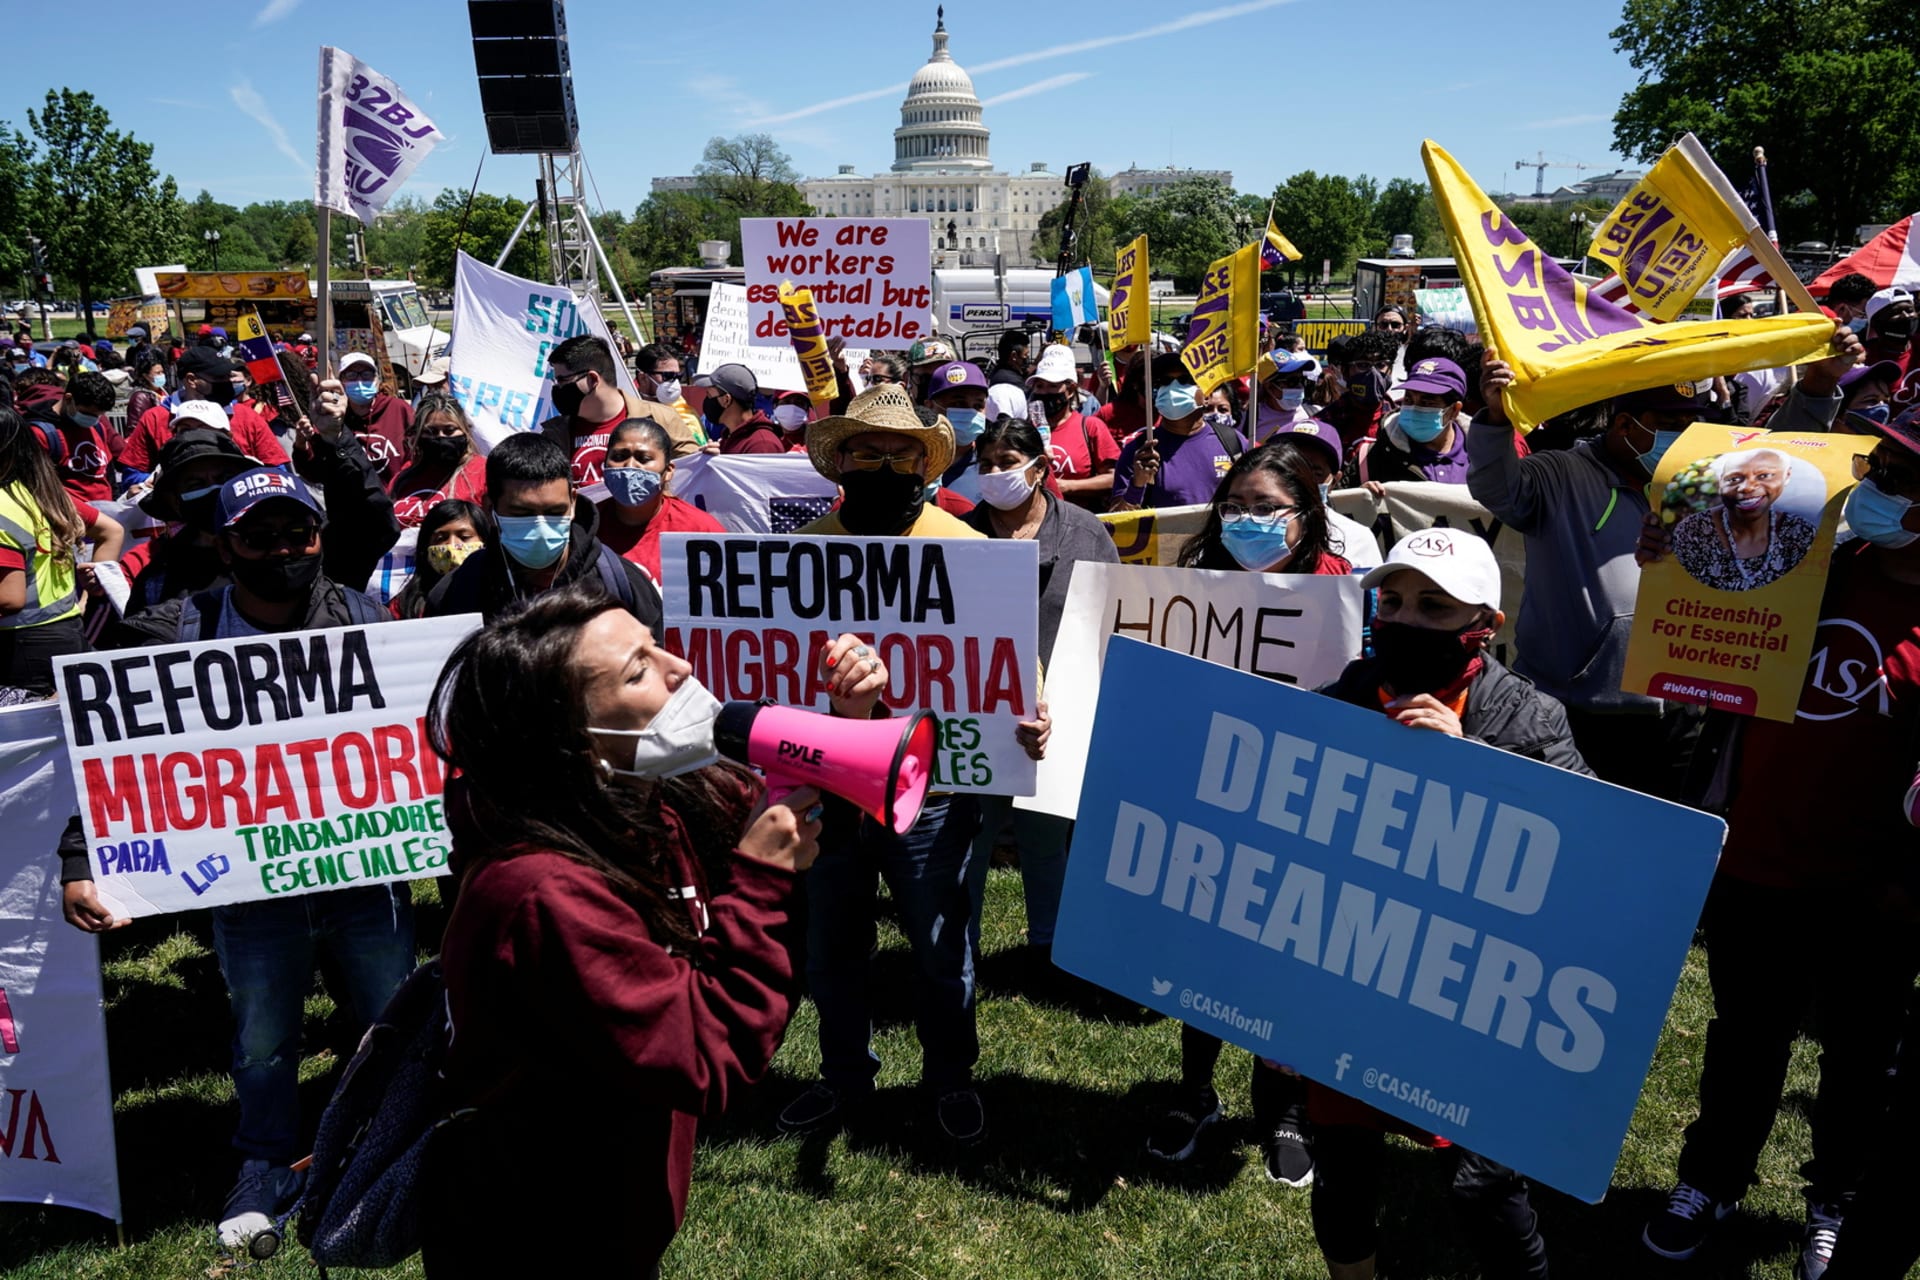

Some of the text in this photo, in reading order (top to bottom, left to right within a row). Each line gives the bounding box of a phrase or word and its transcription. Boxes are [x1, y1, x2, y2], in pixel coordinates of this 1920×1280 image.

[346, 74, 435, 139] 32BJ
[344, 159, 388, 195] EIU
[777, 220, 889, 247] We are
[766, 250, 895, 276] workers
[747, 277, 931, 309] esntial but
[755, 311, 928, 345] dertable.
[966, 309, 1003, 317] PENSK
[575, 434, 610, 448] VACCINAT
[232, 473, 297, 497] BIDEN
[248, 486, 288, 498] HARRIS
[1408, 536, 1454, 556] CASA
[685, 539, 956, 625] REFORMA
[1665, 598, 1783, 631] Citizenship
[1114, 594, 1303, 684] HOME
[1651, 618, 1789, 653] For Essential
[1667, 642, 1762, 671] Workers!
[62, 629, 386, 746] REFORMA
[1661, 681, 1743, 705] #WeAreHome
[1809, 646, 1894, 718] ASA
[82, 716, 463, 839] MIGRATORI
[235, 799, 446, 862] TRABAJADORE
[1194, 711, 1560, 916] DEFEND
[96, 838, 230, 896] PARA LOS
[260, 837, 449, 895] ESENCIALES
[1105, 800, 1617, 1074] DREAMERS
[1178, 988, 1274, 1041] @CASAforAll
[1362, 1067, 1471, 1128] @CASAforAll
